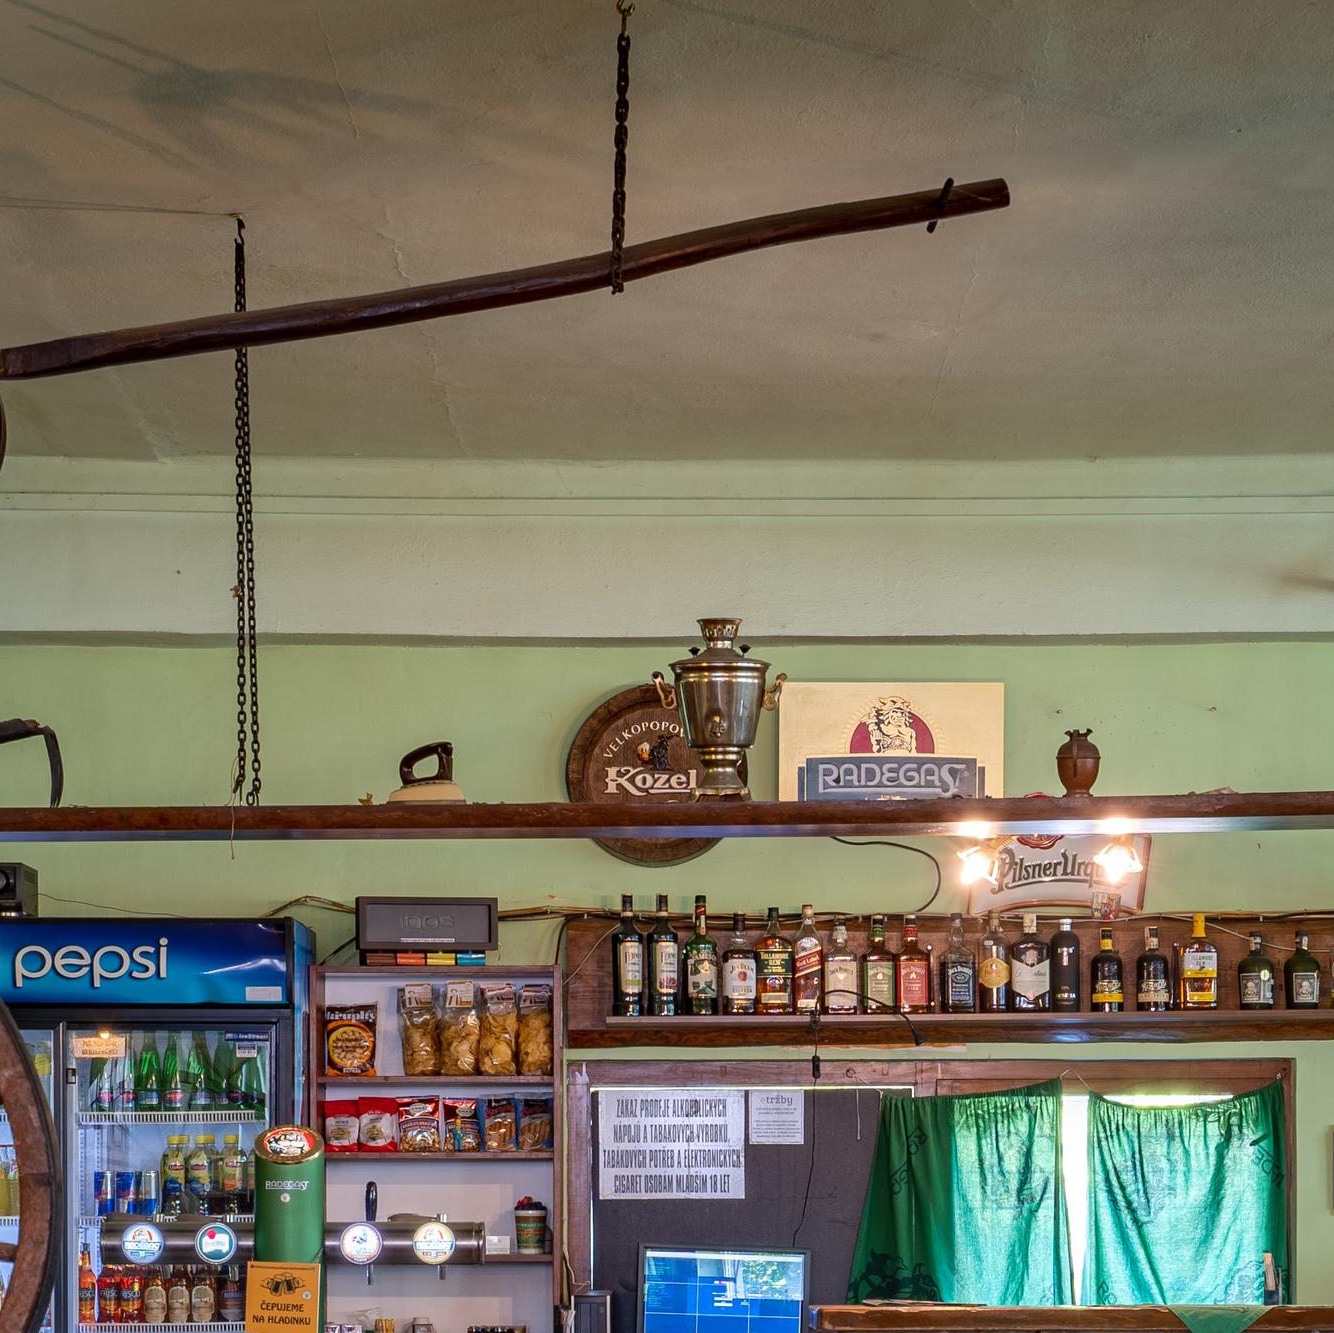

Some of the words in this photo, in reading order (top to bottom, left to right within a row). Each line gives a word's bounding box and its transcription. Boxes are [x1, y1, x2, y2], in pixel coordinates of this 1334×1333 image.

[604, 766, 697, 796] Kozel
[818, 763, 967, 797] RADEGAST
[990, 846, 1063, 895] Pilsner
[15, 937, 168, 988] pepsi
[616, 1096, 638, 1118] ZÁKAZ
[640, 1099, 670, 1118] PRODEJE
[672, 1096, 727, 1118] ALKOHOLICKÝCH
[613, 1121, 641, 1143] NÁPOJŮ
[643, 1125, 648, 1143] A
[650, 1121, 695, 1143] TABÁKOVÝCH
[603, 1146, 647, 1168] TABÁKOVÝCH
[649, 1146, 675, 1168] POTŘEB
[677, 1150, 682, 1168] A
[684, 1146, 741, 1168] ELEKTRONICKÝCH
[265, 1180, 310, 1191] RADEGAST
[614, 1175, 642, 1194] CIGARET
[644, 1171, 674, 1194] OSOBÁM
[675, 1171, 708, 1194] MLADŠÍM
[710, 1175, 718, 1193] 18
[720, 1175, 730, 1193] LET
[260, 1300, 304, 1312] ČEPUJEME
[252, 1315, 265, 1324] NA
[267, 1314, 311, 1325] HLADINKU
